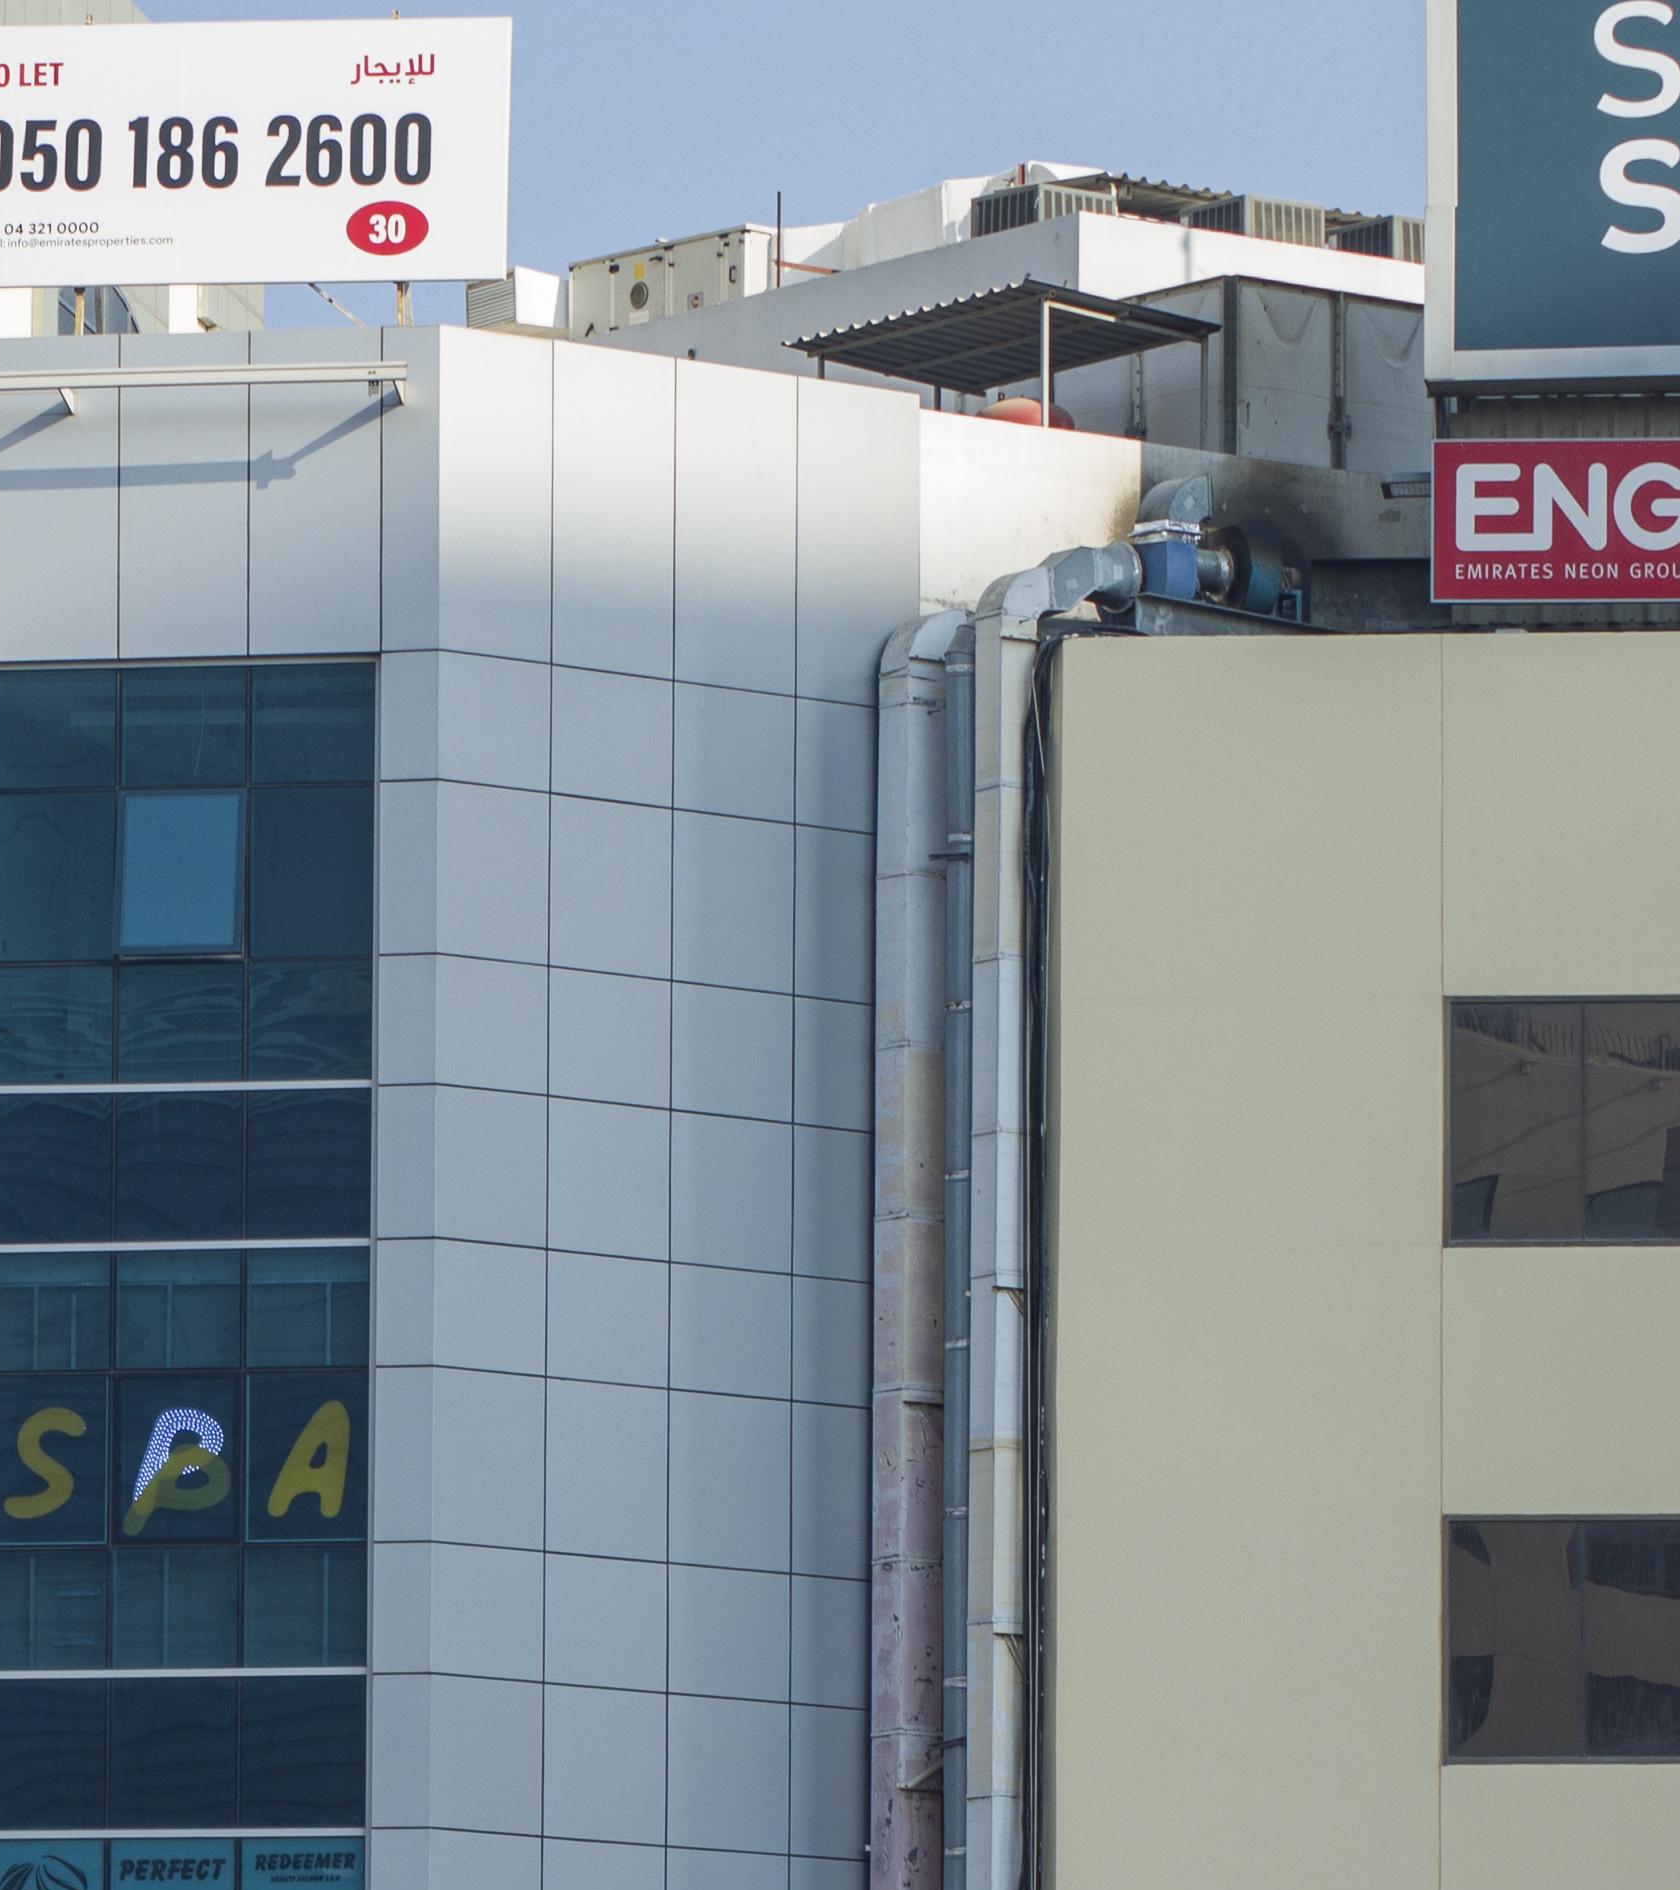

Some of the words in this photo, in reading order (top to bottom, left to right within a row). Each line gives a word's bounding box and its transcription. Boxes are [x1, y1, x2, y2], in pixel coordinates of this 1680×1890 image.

[18, 62, 64, 87] LET
[351, 54, 436, 85] للإيجار
[128, 115, 239, 189] 186
[265, 112, 432, 187] 2600
[4, 223, 24, 236] 04
[28, 223, 53, 236] 321
[56, 222, 100, 235] 0000
[369, 214, 406, 244] 30
[1455, 562, 1553, 580] EMIRATES
[1564, 562, 1619, 580] NEON
[3, 1400, 350, 1537] SPA
[119, 1858, 226, 1882] PERFECT
[254, 1852, 356, 1872] REDEEMER
